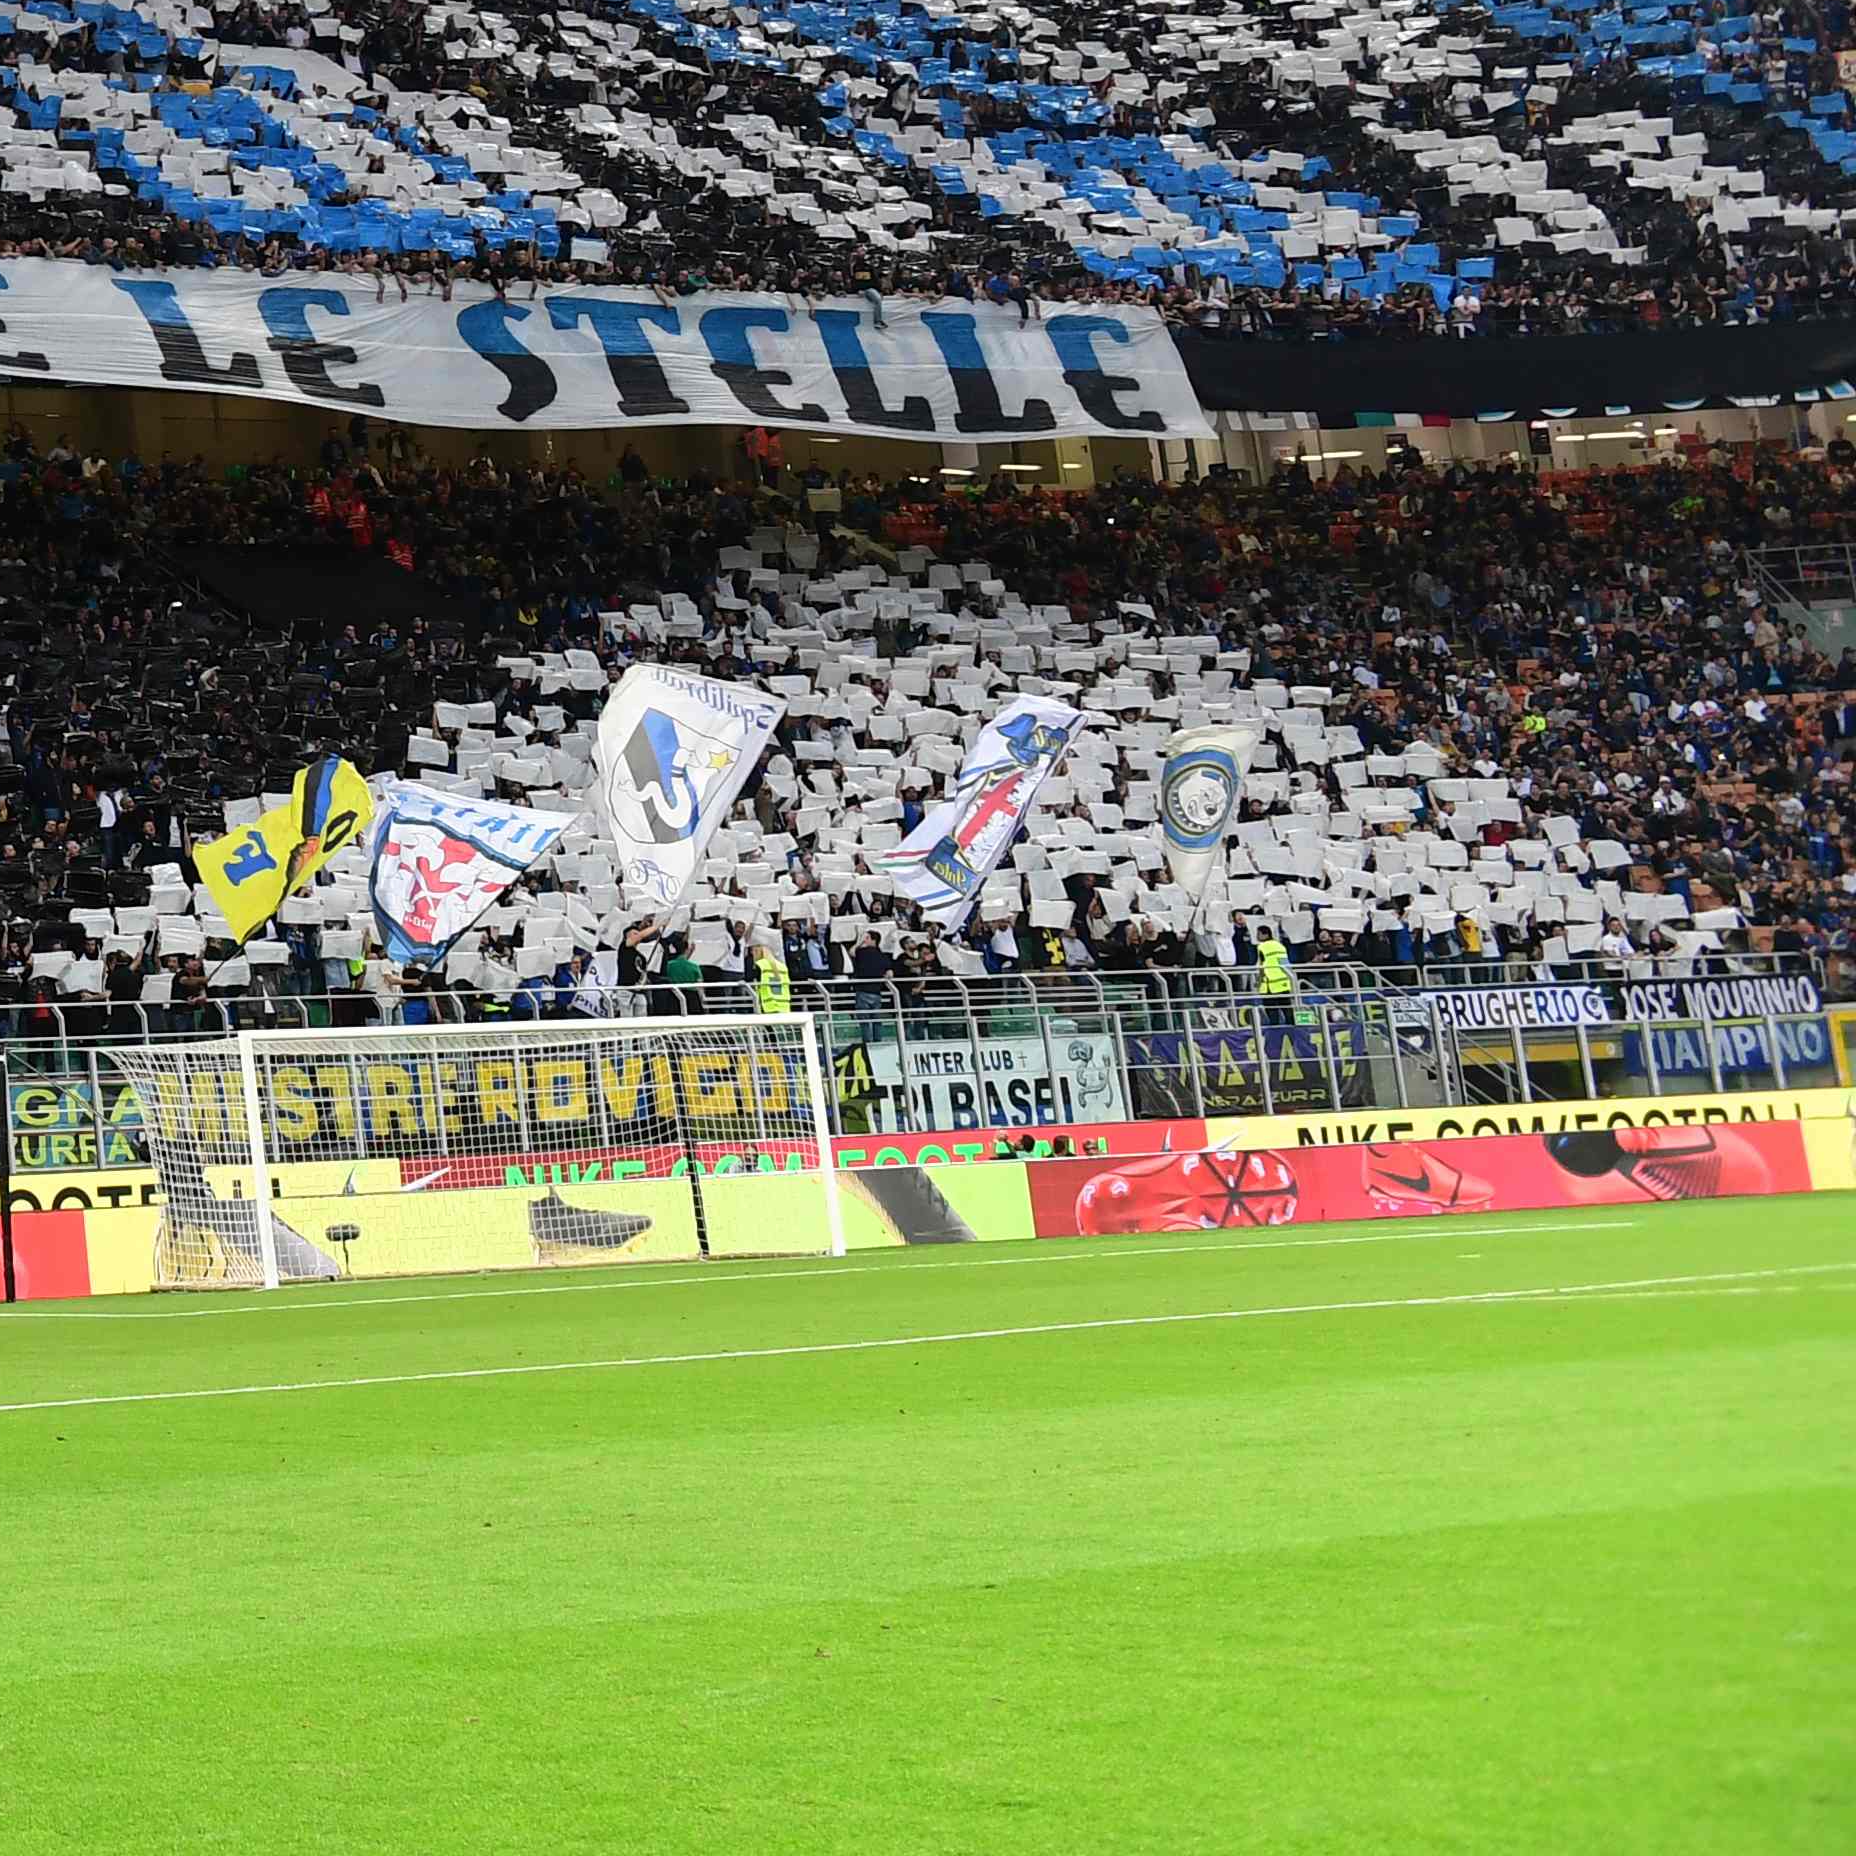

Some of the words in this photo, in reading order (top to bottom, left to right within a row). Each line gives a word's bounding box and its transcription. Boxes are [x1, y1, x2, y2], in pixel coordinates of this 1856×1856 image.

[111, 278, 385, 408] LE
[456, 295, 1168, 433] STELLE
[1437, 990, 1579, 1028] BRUGHERIO
[1684, 975, 1818, 1020] MOURINHO
[914, 1050, 964, 1074] INTER
[475, 1050, 791, 1124] ROVIGO
[1297, 1103, 1803, 1147] NIKECOM/FOOTBALL
